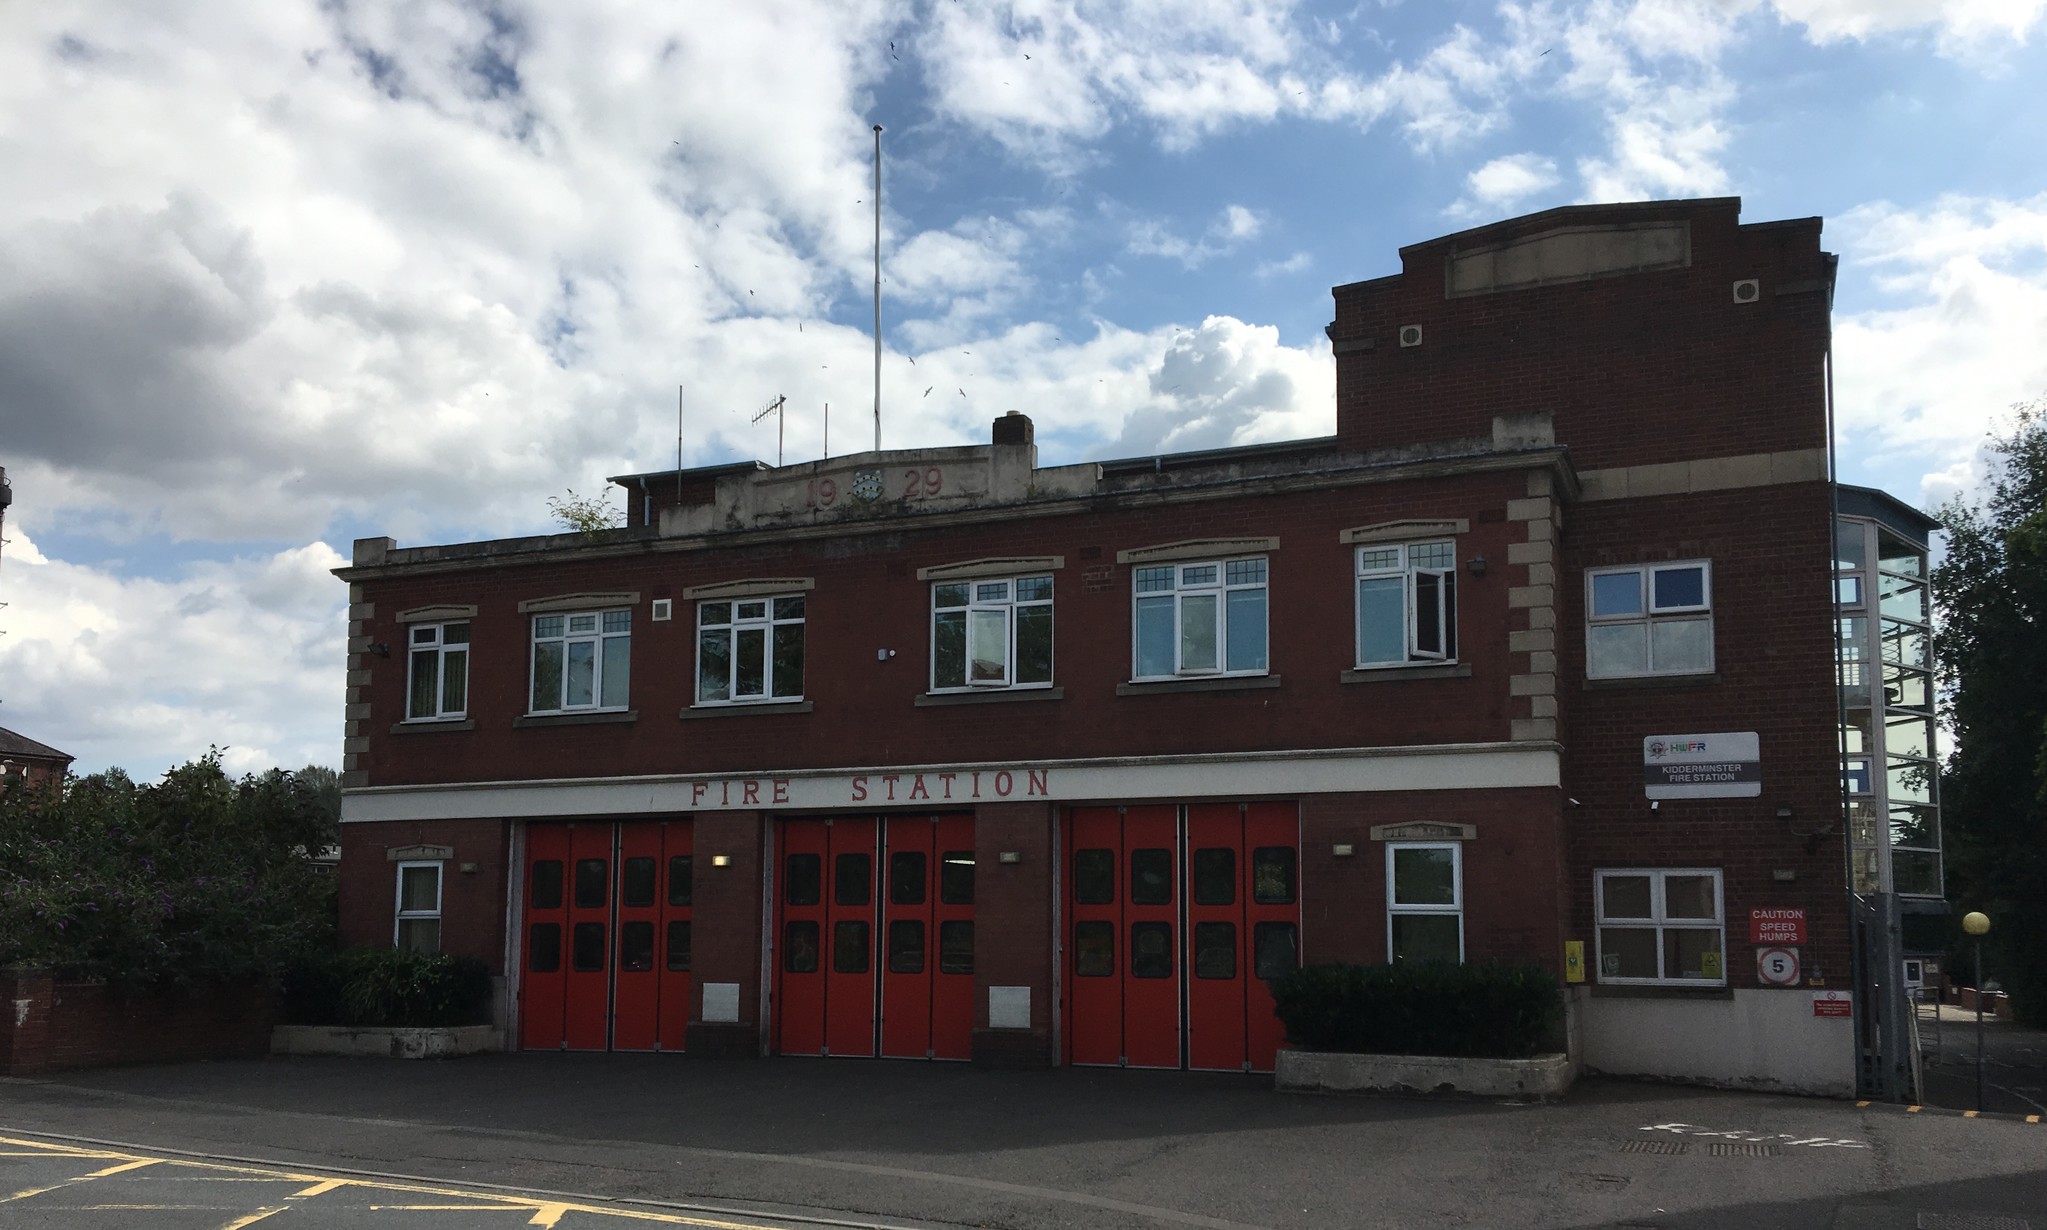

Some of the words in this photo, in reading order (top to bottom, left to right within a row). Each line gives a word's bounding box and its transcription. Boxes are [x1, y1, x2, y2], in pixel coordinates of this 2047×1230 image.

[807, 478, 837, 508] 19
[902, 466, 942, 498] 29
[1670, 742, 1706, 752] HWFR
[1662, 764, 1742, 774] KIDDERMINSTER
[1669, 774, 1691, 782] FIRE
[1693, 773, 1735, 782] STATION
[691, 779, 790, 806] FIRE
[851, 768, 1049, 802] STATION
[1752, 910, 1803, 919] CAUTION
[1760, 923, 1796, 931] SPEED
[1759, 932, 1798, 941] HUMPS
[1772, 959, 1785, 973] 5
